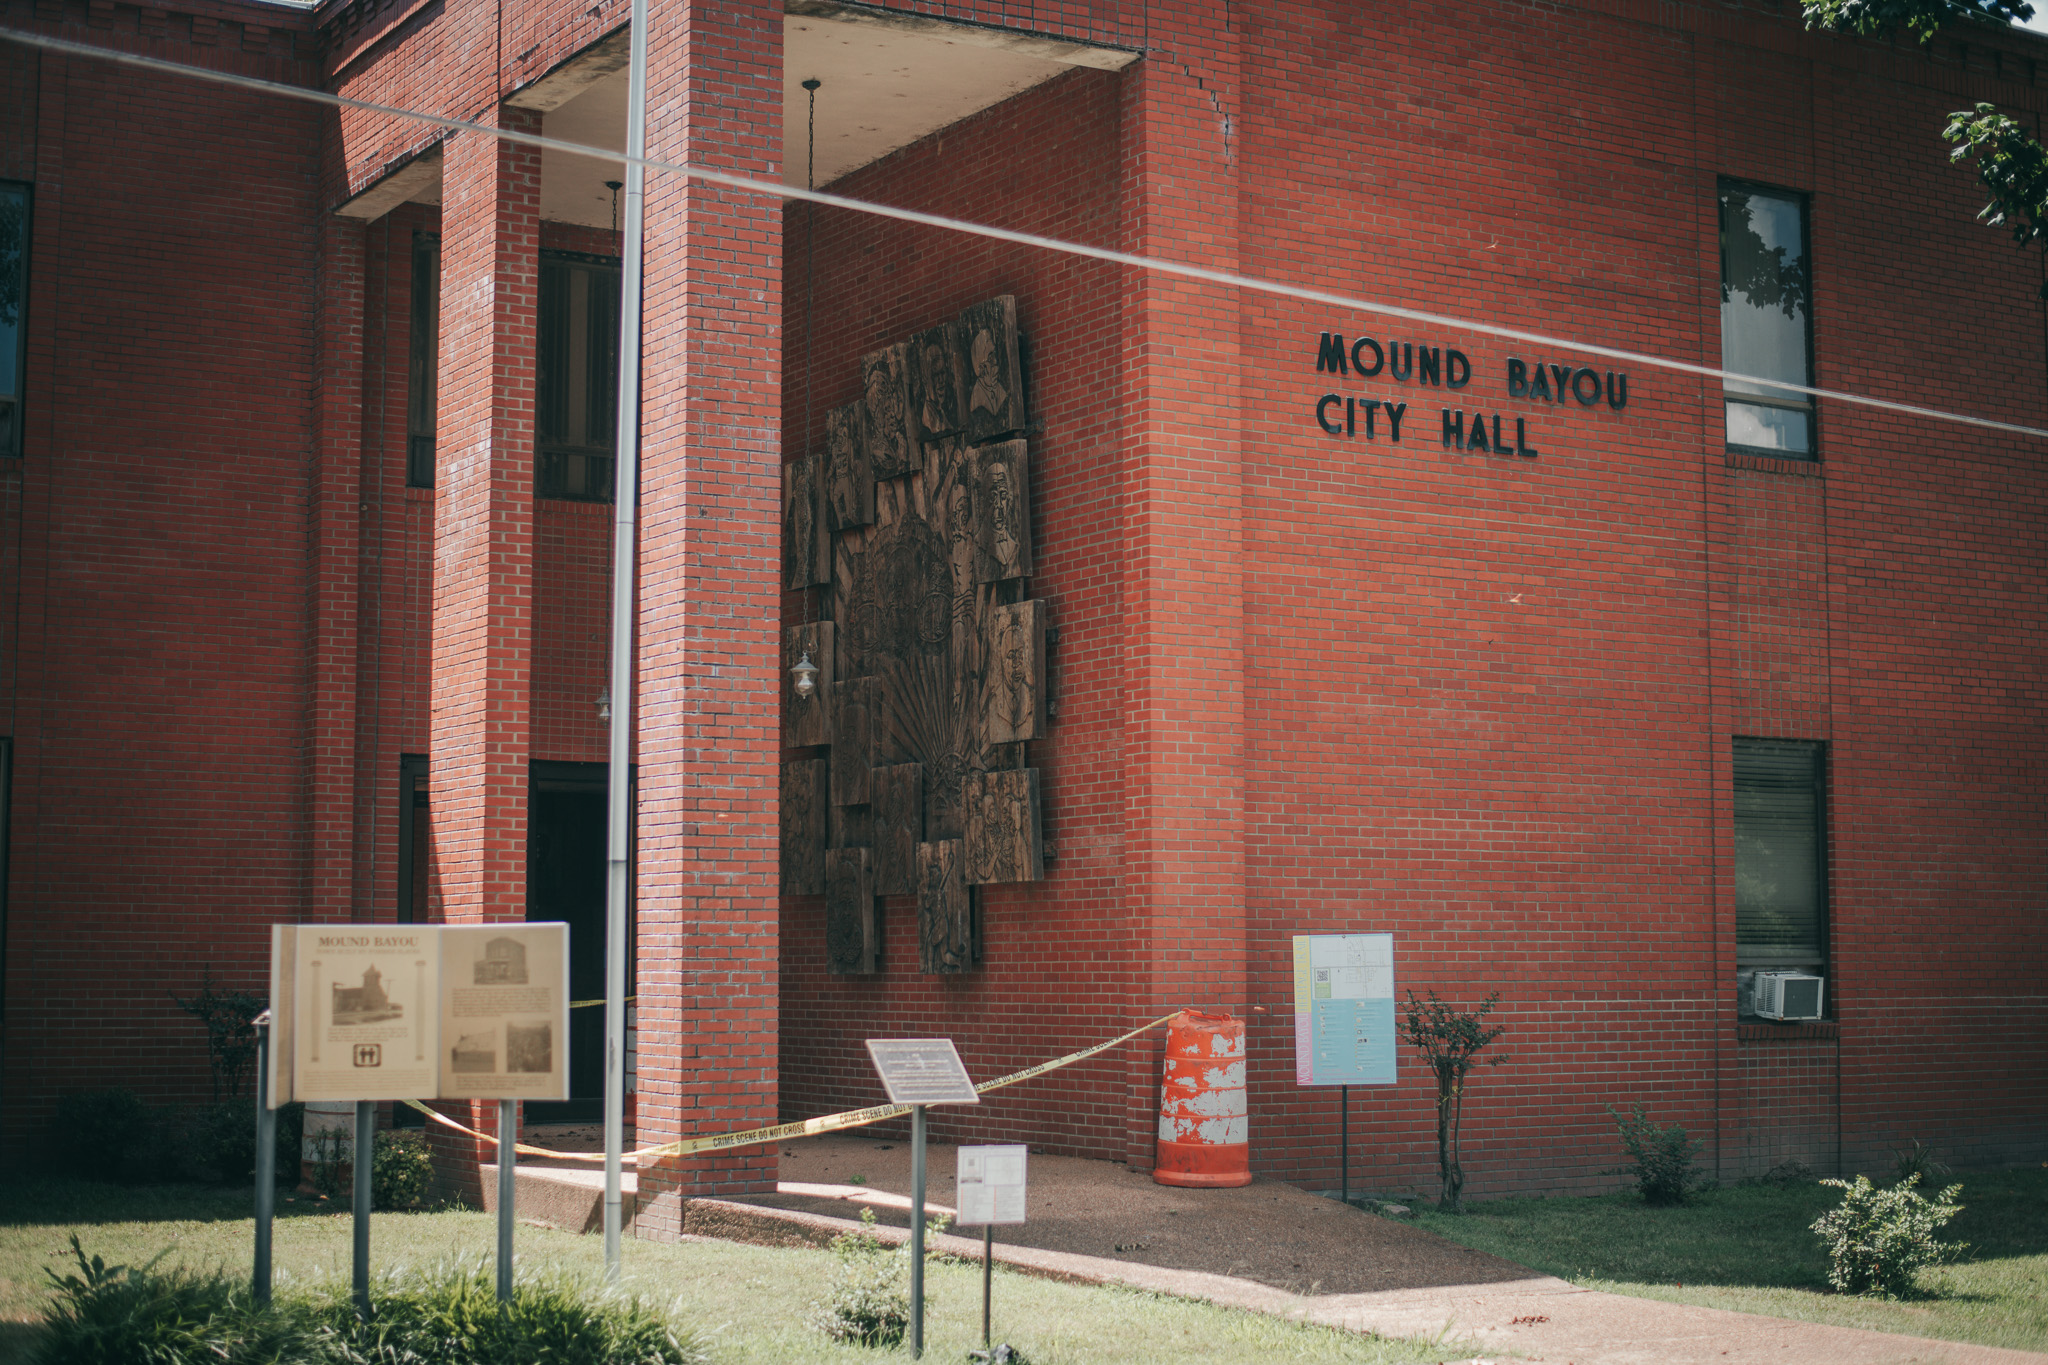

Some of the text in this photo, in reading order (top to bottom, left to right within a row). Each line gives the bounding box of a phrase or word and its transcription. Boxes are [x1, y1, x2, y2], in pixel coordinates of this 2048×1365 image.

[1316, 331, 1628, 411] MOUND BAYOU
[1316, 393, 1538, 458] CITY HALL
[318, 936, 419, 947] MOUND BAYOU
[1295, 940, 1310, 1083] MOUND BAYOU HERITAGE TRAIL
[712, 1122, 806, 1148] CRIME SCENE DO NOT CROSS
[839, 1112, 861, 1125] CRIME
[861, 1107, 882, 1120] SCENE
[883, 1105, 893, 1116] DO
